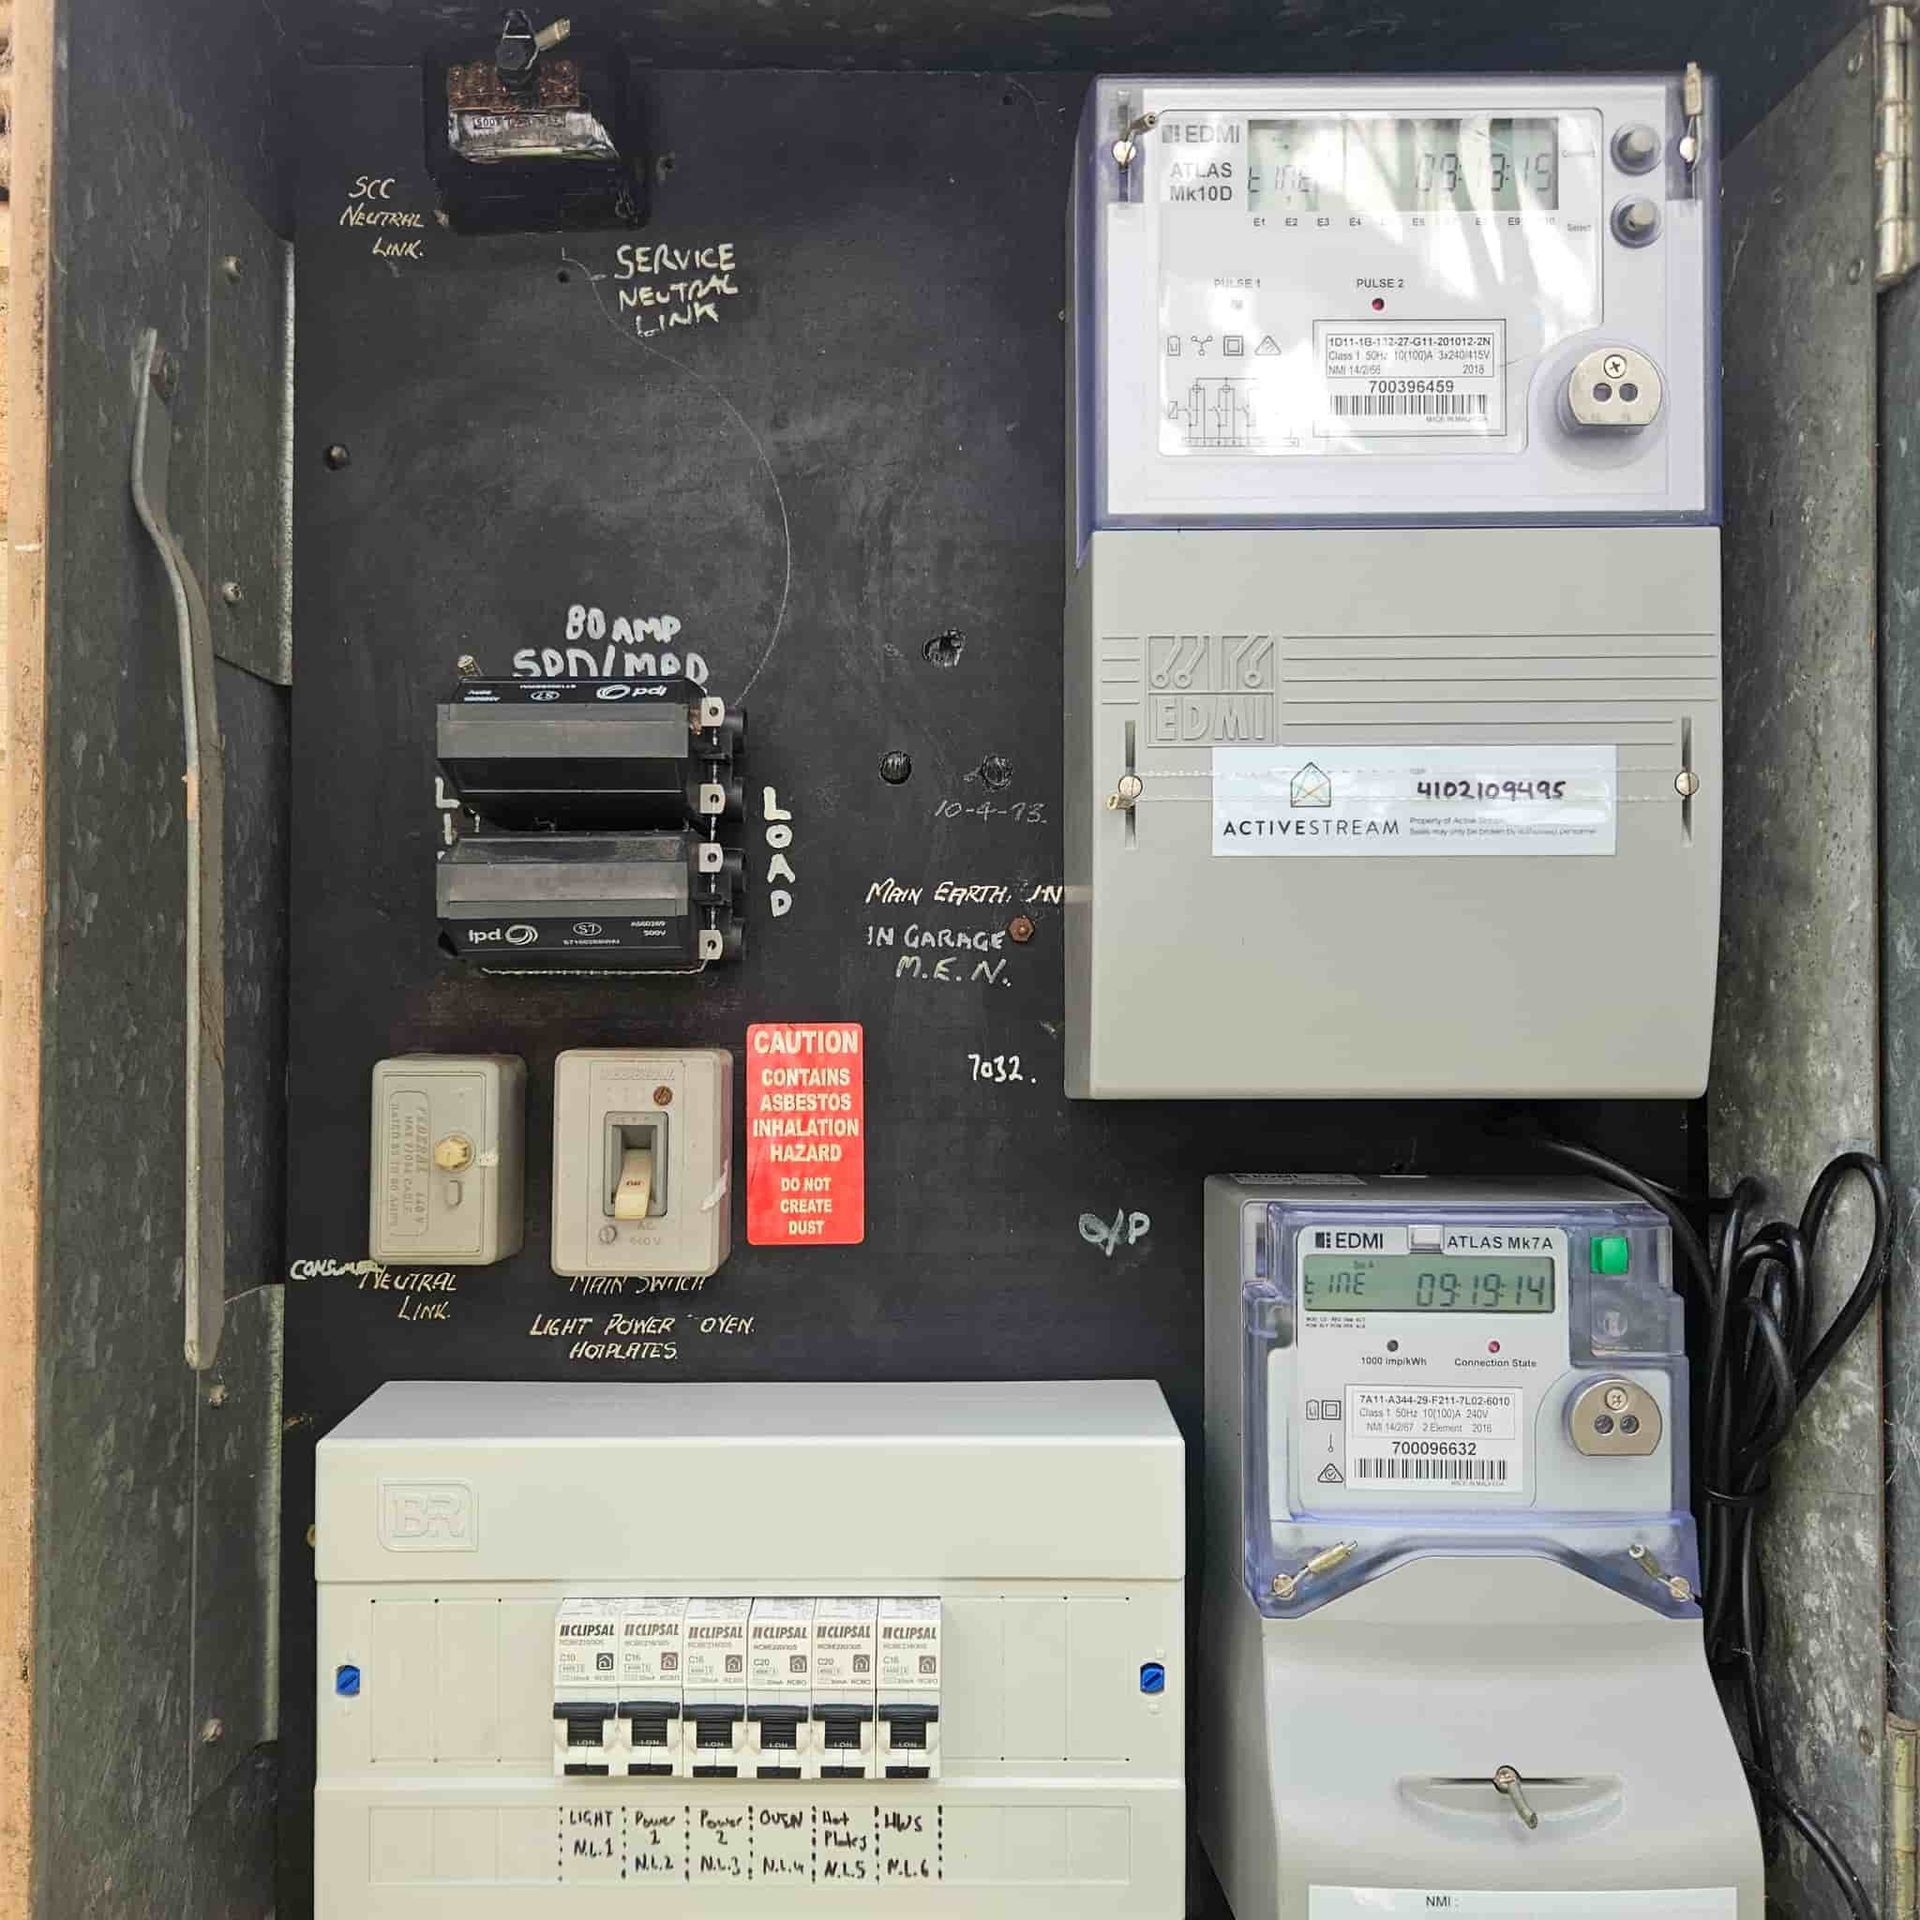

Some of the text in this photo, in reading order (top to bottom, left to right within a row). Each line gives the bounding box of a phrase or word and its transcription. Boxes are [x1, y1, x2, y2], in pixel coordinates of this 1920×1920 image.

[1185, 124, 1240, 143] EDMI
[1170, 162, 1232, 178] ATLAS
[348, 175, 396, 200] SCC
[1170, 185, 1232, 201] Mk10D
[339, 205, 424, 229] NEUTRAL
[614, 243, 736, 279] SERVICE
[1356, 278, 1404, 288] PULSE 2
[618, 273, 739, 312] NEUTRAL
[635, 301, 720, 338] LINK
[1369, 380, 1454, 393] 700396459
[565, 604, 681, 645] 80 AMP
[1156, 695, 1266, 741] EDMI
[1223, 820, 1400, 837] ACTIVESTREAM
[865, 877, 924, 905] MAIN
[904, 923, 1006, 953] GARAGE
[753, 1030, 859, 1055] CAUTION
[761, 1068, 851, 1087] CONTAINS
[760, 1093, 852, 1112] ASBESTOS
[752, 1118, 860, 1137] INHALATION
[769, 1143, 843, 1162] HAZARD
[780, 1177, 832, 1191] DO NOT
[779, 1198, 832, 1213] CREATE
[788, 1220, 825, 1235] DUST
[1335, 1232, 1553, 1250] EDMI ATLAS Mk7A
[358, 1268, 457, 1293] NEUTRAL
[1416, 1273, 1546, 1307] 09:19:14
[529, 1314, 594, 1336] LIGHT
[603, 1313, 676, 1336] POWER
[1361, 1357, 1427, 1367] 1000 imp/kWh
[1454, 1358, 1537, 1367] Connection State
[1359, 1409, 1384, 1418] Class
[1395, 1409, 1418, 1418] 50Hz
[1423, 1409, 1461, 1419] 10(100)A
[1466, 1409, 1489, 1418] 240V
[1366, 1422, 1382, 1432] NMI
[1391, 1441, 1477, 1456] 700096632
[571, 1624, 615, 1636] CLIPSAL
[635, 1623, 679, 1636] CLIPSAL
[699, 1626, 743, 1639] CLIPSAL
[763, 1626, 808, 1639] CLIPSAL
[827, 1626, 871, 1639] CLIPSAL
[893, 1626, 937, 1639] CLIPSAL
[569, 1809, 613, 1828] LIGHT
[634, 1810, 675, 1827] Power
[700, 1809, 743, 1829] Power
[822, 1810, 850, 1826] Hot
[884, 1811, 923, 1832] HWS
[715, 1829, 728, 1845] 2
[1425, 1895, 1452, 1908] NMI
